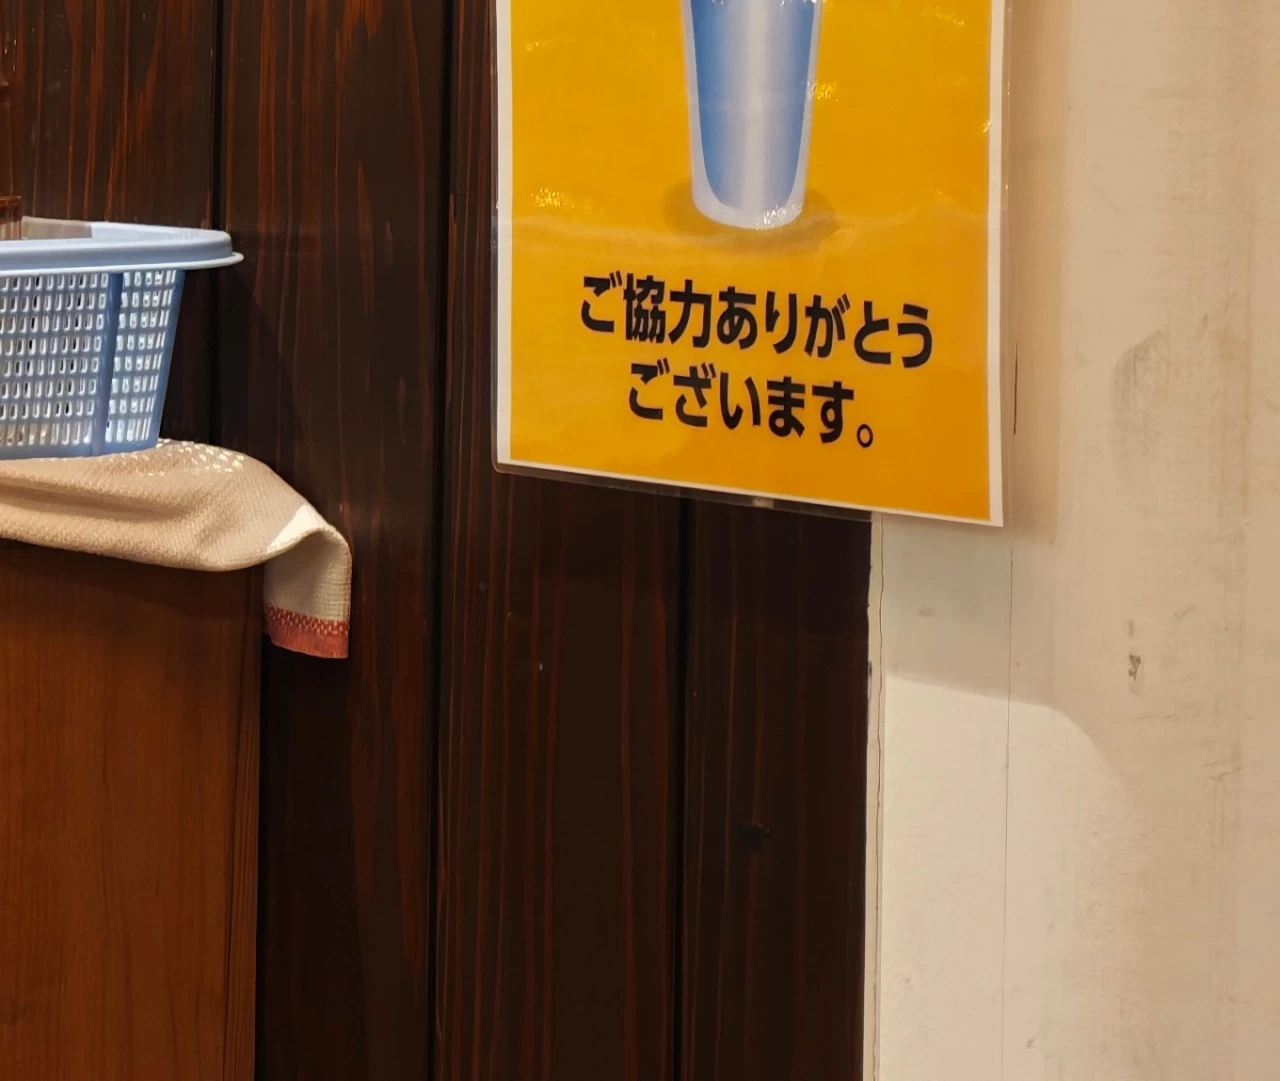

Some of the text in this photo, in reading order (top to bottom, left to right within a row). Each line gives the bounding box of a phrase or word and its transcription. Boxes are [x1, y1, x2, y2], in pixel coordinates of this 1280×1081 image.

[580, 269, 933, 369] ご協力ありがとう
[628, 357, 874, 450] ございます。
